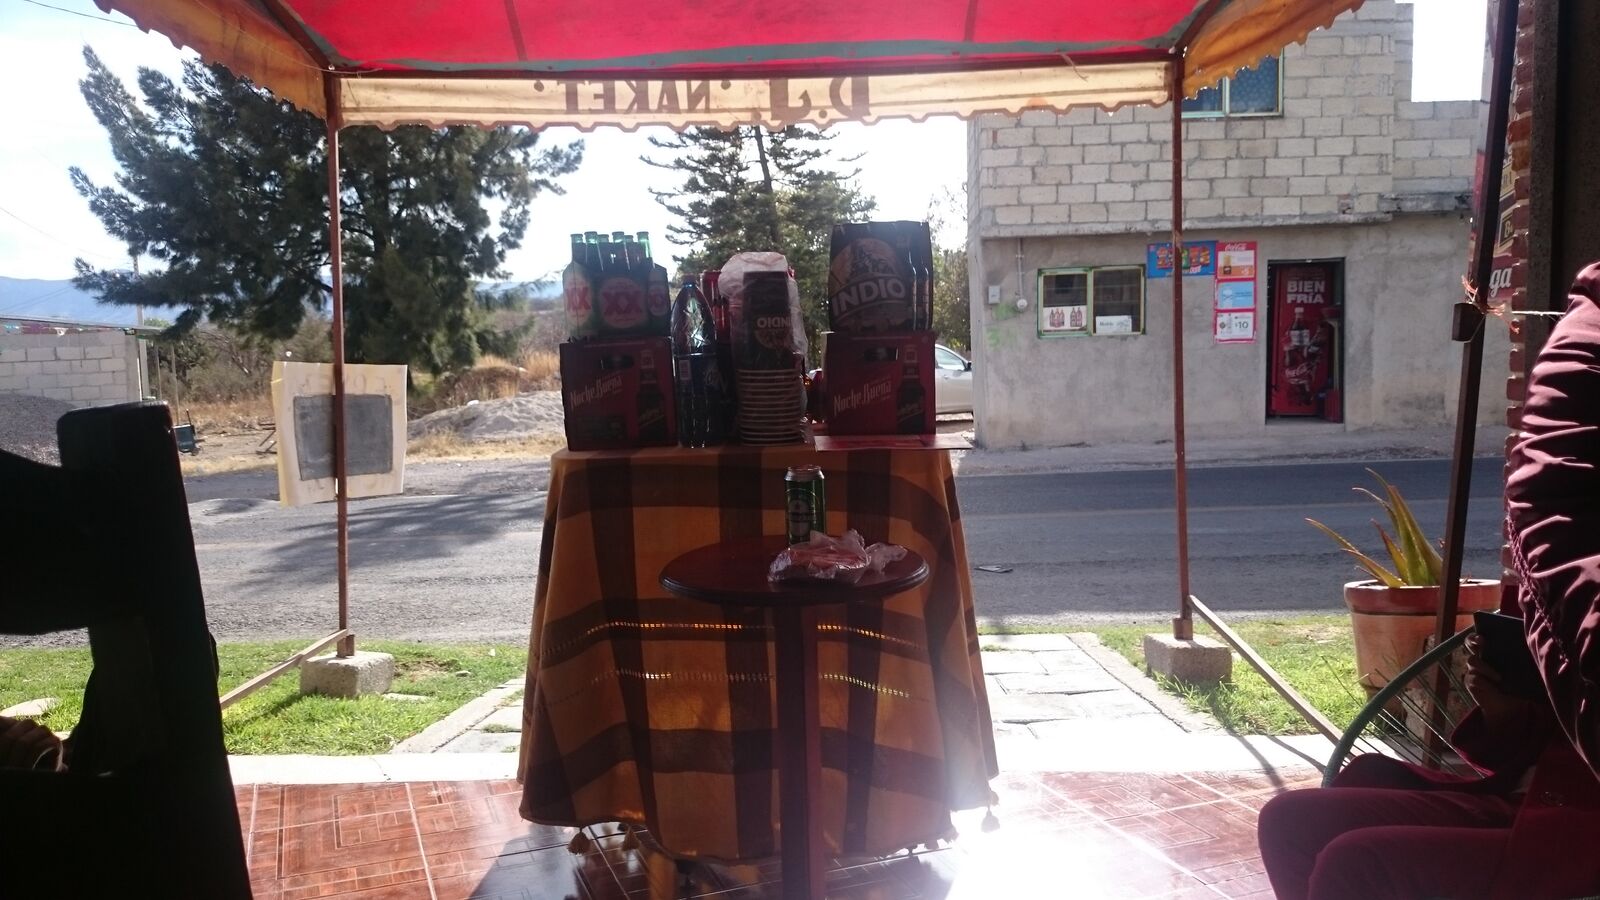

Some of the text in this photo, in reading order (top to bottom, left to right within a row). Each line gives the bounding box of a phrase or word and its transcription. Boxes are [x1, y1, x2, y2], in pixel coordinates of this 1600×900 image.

[832, 279, 905, 317] INDIO
[1287, 280, 1326, 293] BIEN
[756, 316, 791, 329] INDIO
[570, 374, 623, 411] Noche Buena
[833, 380, 892, 417] Noche Buena
